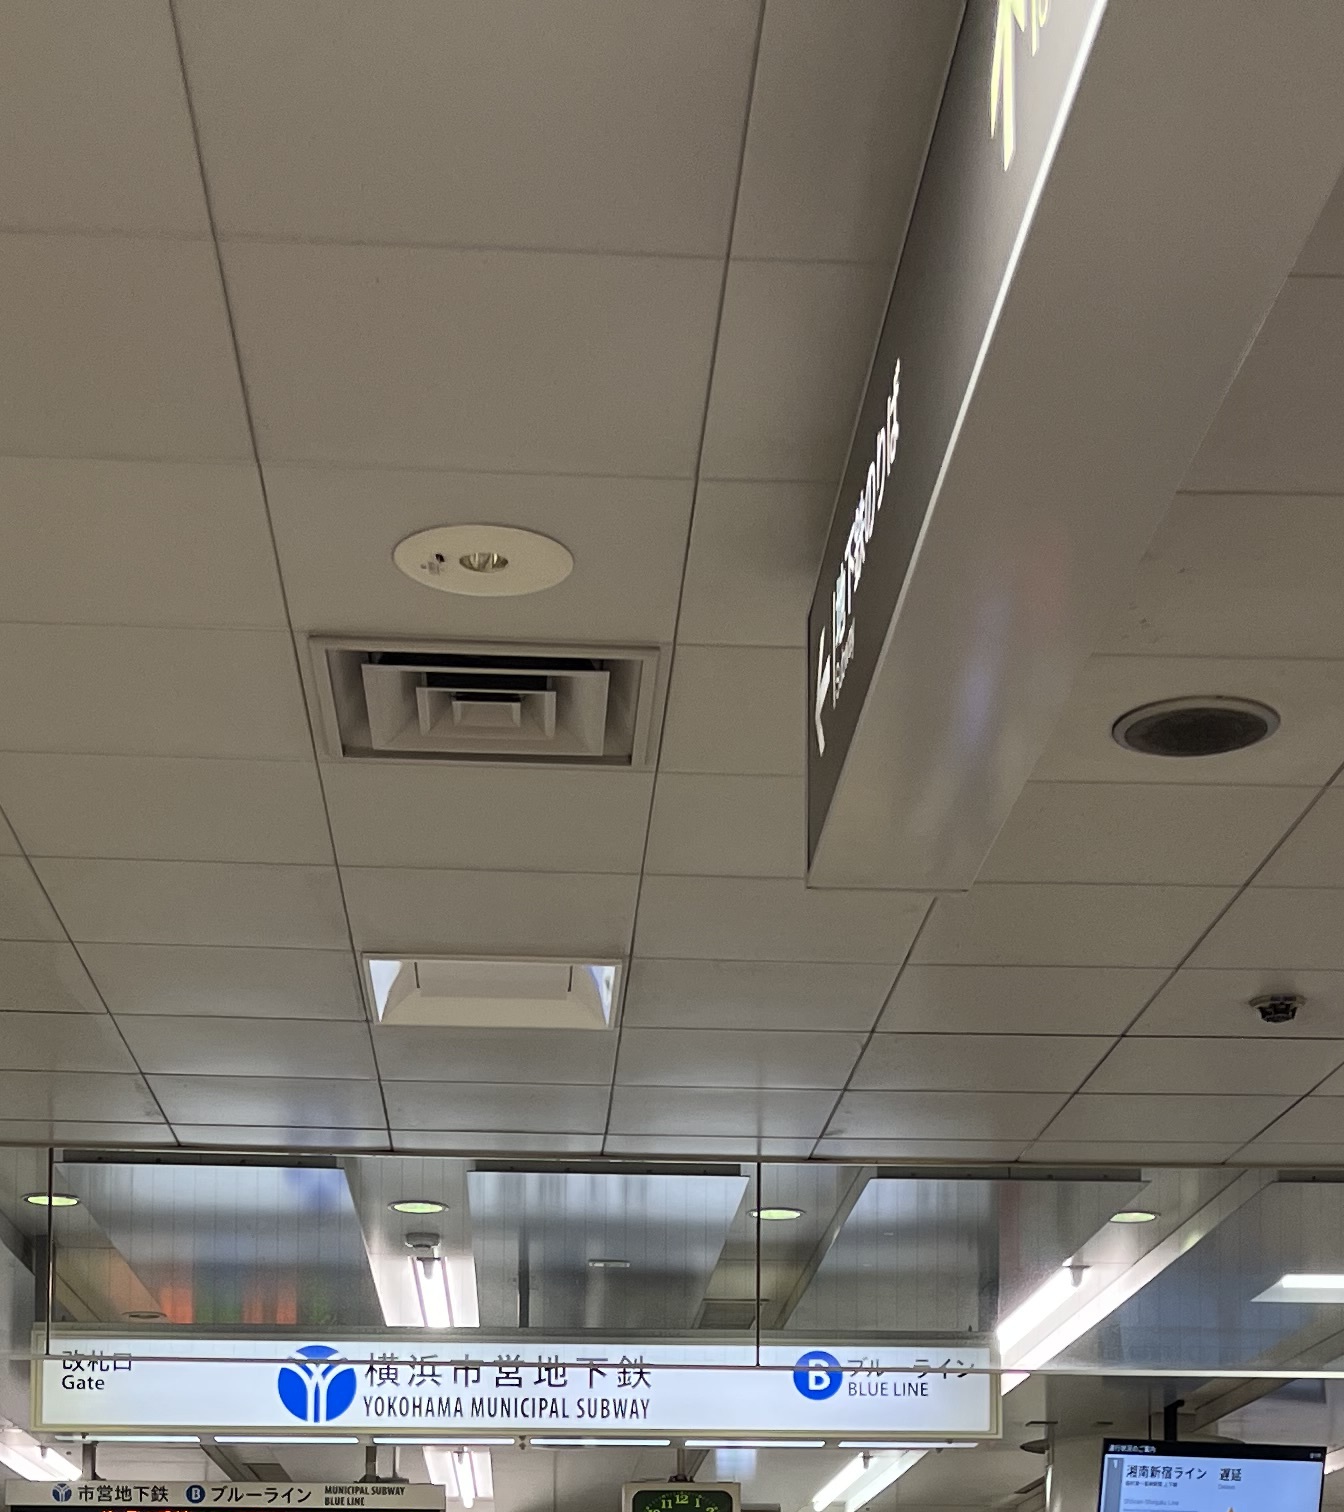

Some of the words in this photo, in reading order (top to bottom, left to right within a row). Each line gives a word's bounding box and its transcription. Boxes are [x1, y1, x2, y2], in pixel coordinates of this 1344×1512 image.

[364, 1352, 653, 1389] 横浜市営地下鉄
[62, 1376, 105, 1390] Gate
[847, 1382, 889, 1397] BLUE
[893, 1382, 929, 1397] LINE
[363, 1397, 464, 1420] YOKOHAMA
[469, 1397, 570, 1420] MUNICIPAL
[576, 1397, 651, 1421] SUBWAY
[1126, 1464, 1207, 1480] 湘南新宿ライン
[79, 1486, 170, 1502] 市営地下鉄
[211, 1487, 312, 1501] ブルーライン
[324, 1486, 370, 1496] MUNICIPAL
[371, 1486, 406, 1496] SUBWAY
[324, 1497, 343, 1506] BLUE
[345, 1497, 366, 1506] LINE
[661, 1499, 673, 1509] 11
[675, 1494, 688, 1504] 12
[695, 1498, 700, 1508] 1
